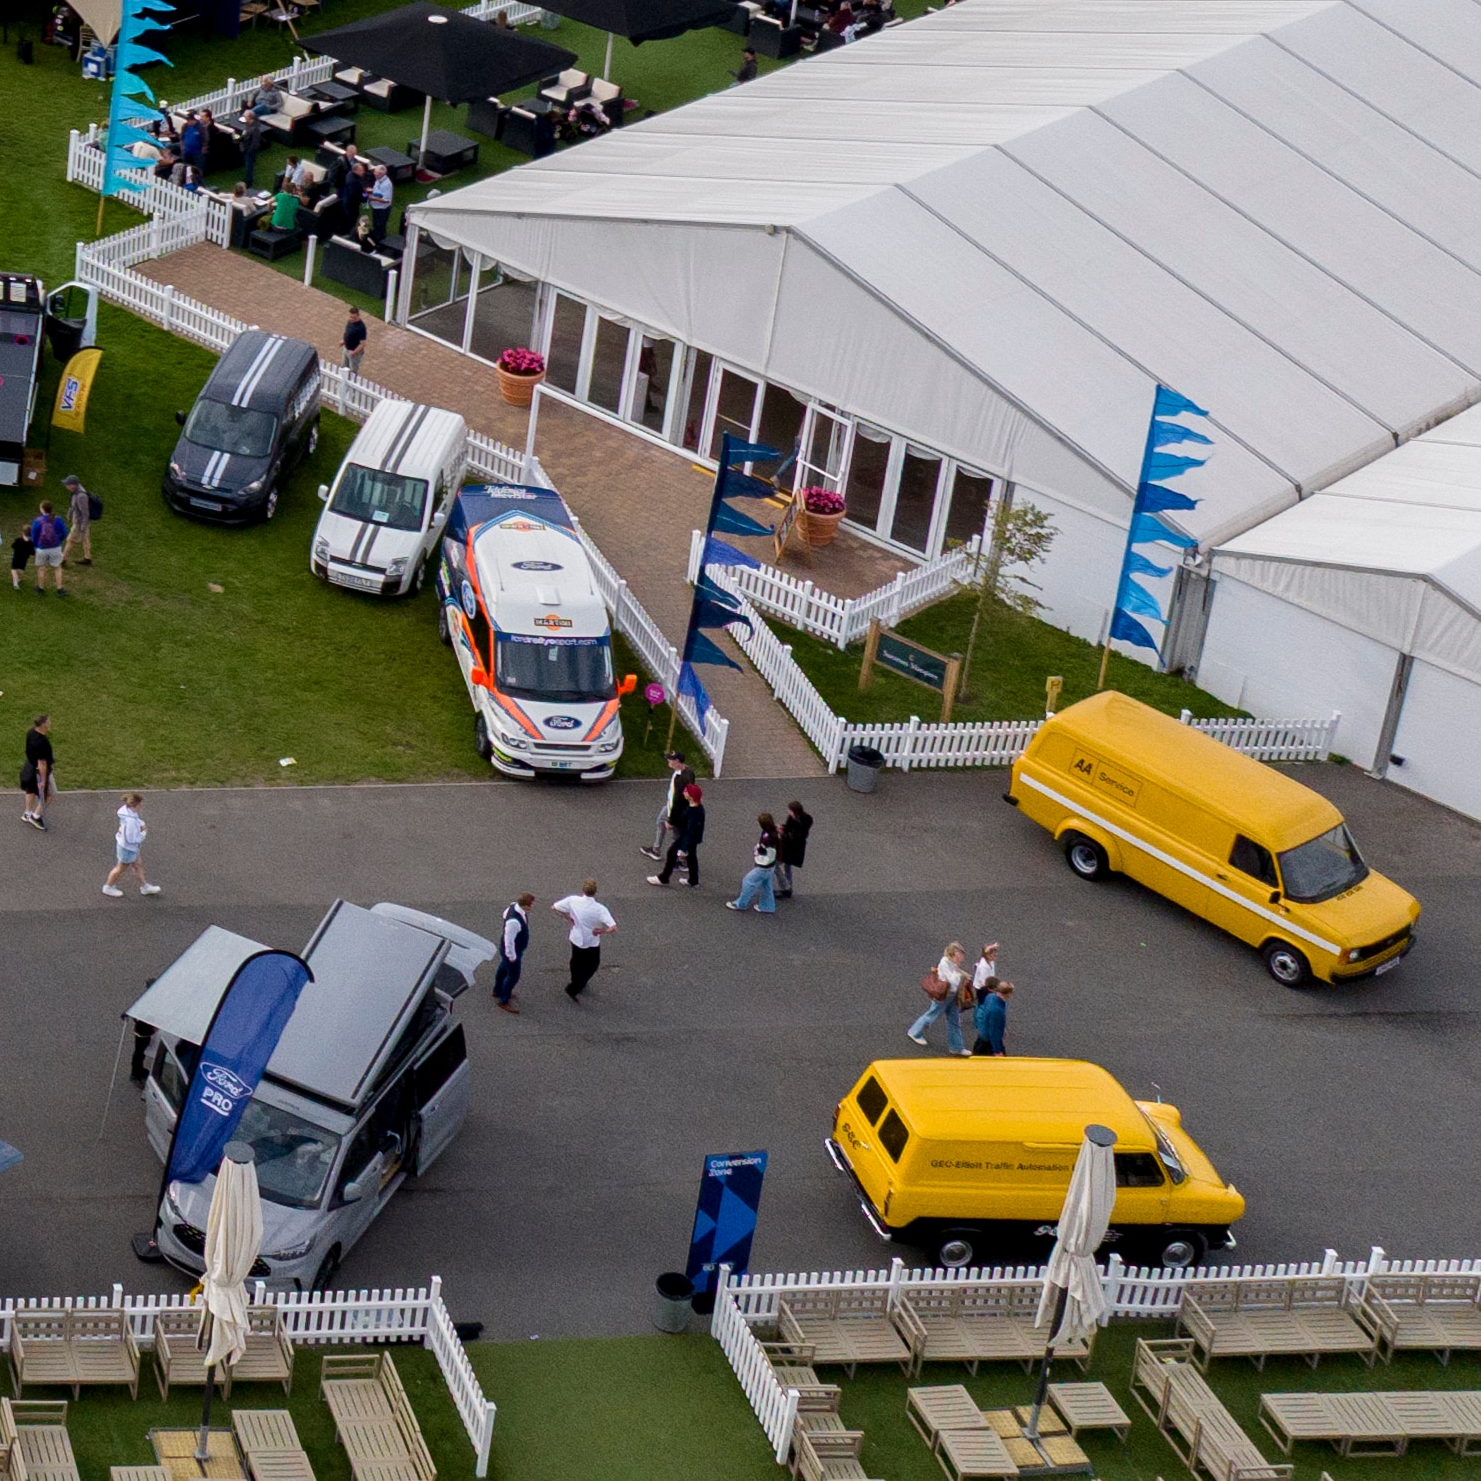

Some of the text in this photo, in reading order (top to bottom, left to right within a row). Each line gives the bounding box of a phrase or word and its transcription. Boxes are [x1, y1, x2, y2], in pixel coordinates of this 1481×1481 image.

[60, 377, 80, 411] VFS
[549, 715, 576, 730] Ford
[1073, 758, 1134, 797] AA Service
[202, 1086, 234, 1113] PRO
[710, 1157, 764, 1167] Conversion
[1016, 1162, 1070, 1173] Automation
[709, 1167, 734, 1178] Zone
